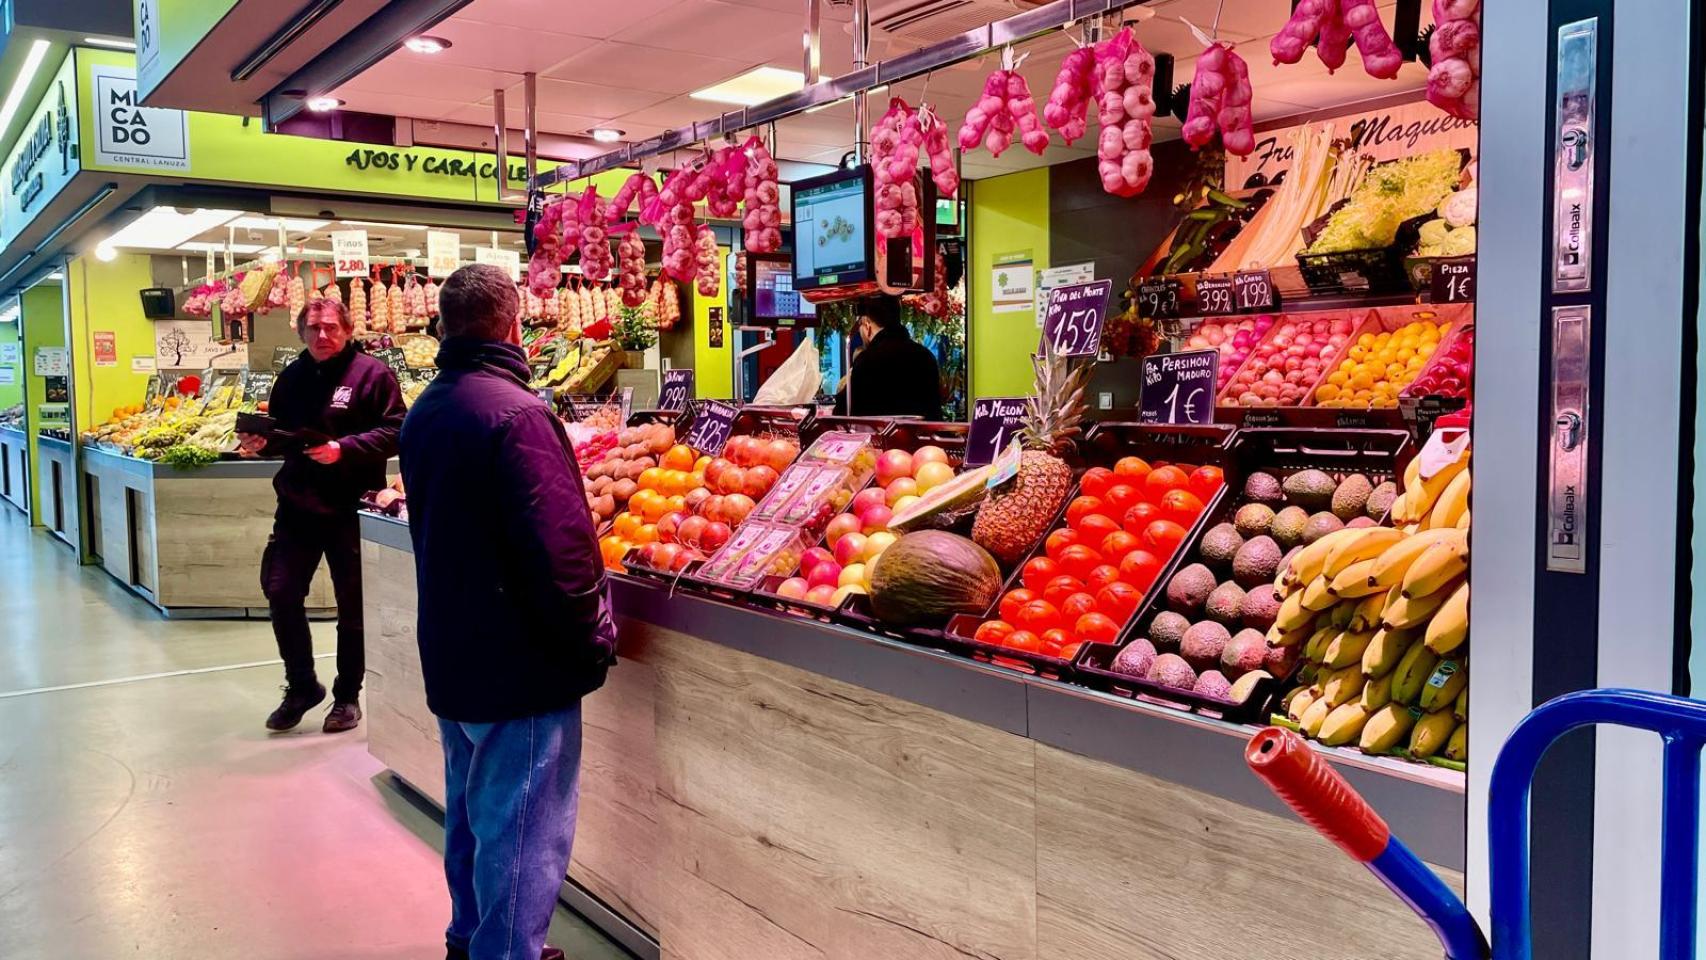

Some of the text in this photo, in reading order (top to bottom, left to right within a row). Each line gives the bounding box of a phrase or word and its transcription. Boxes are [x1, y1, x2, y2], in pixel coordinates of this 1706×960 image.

[111, 108, 147, 126] CA
[112, 126, 151, 145] DO
[113, 155, 186, 167] CENTRAL LANUZA
[346, 149, 399, 170] AJOS
[404, 154, 418, 171] Y
[1441, 264, 1469, 275] PIEZA
[1083, 286, 1104, 298] MONTE
[1177, 369, 1212, 381] MADURO
